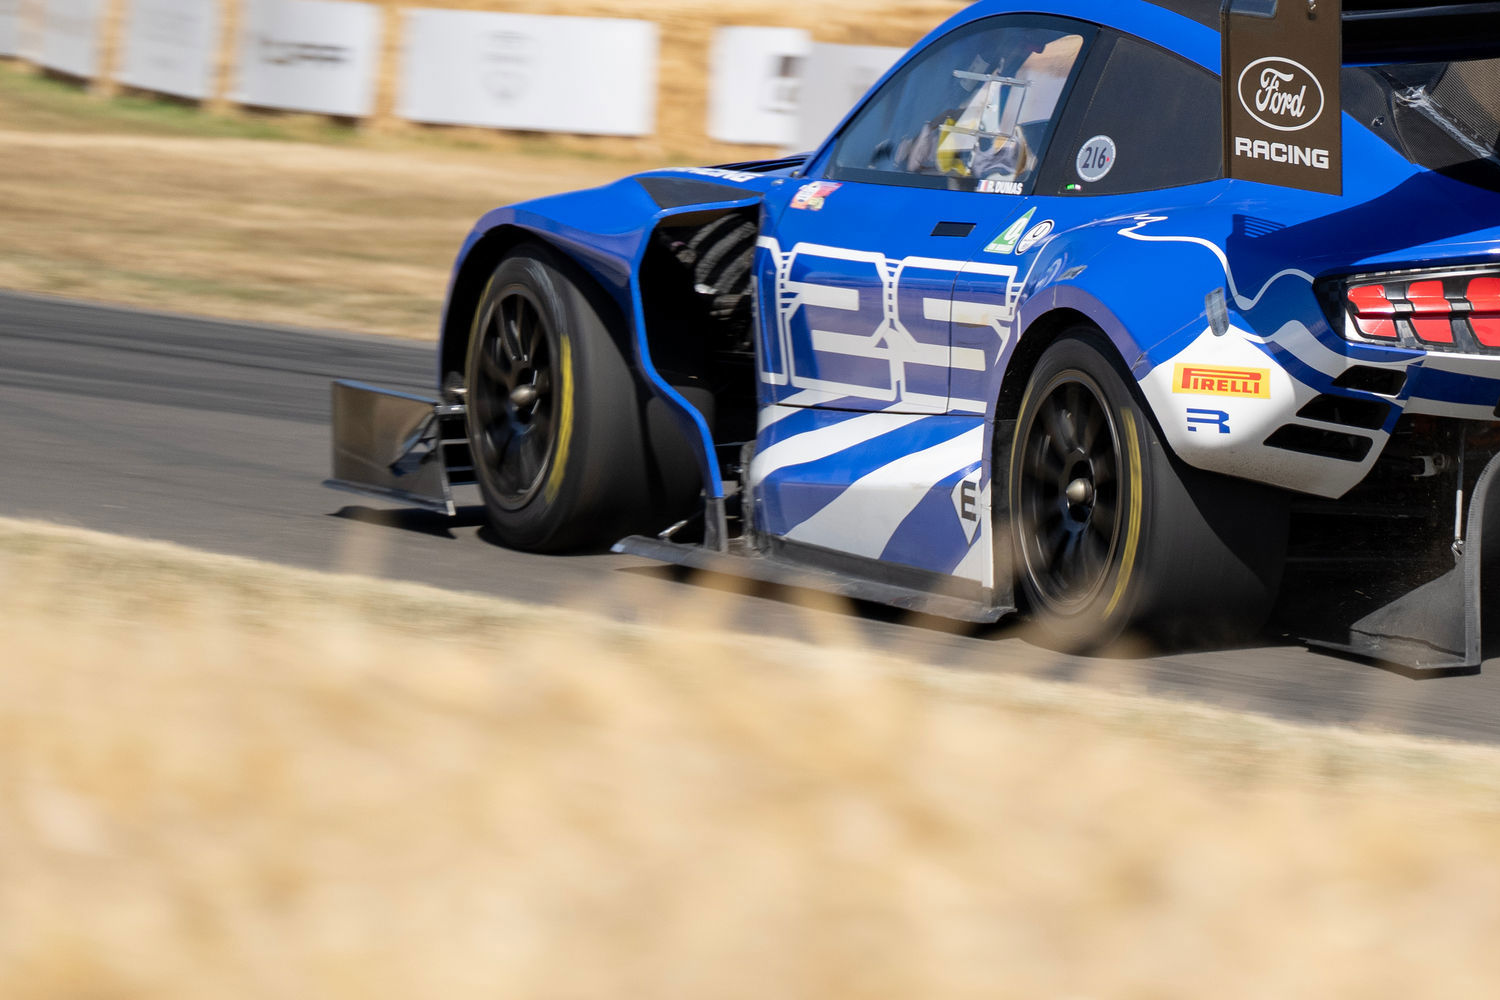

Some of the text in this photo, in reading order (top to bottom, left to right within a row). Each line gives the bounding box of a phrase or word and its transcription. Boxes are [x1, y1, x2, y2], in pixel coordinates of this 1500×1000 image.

[1255, 67, 1307, 118] Ford
[1081, 146, 1106, 169] 216
[1234, 136, 1330, 170] RACING
[995, 180, 1024, 195] DUMAS
[1181, 367, 1262, 395] PIRELLI
[960, 479, 977, 522] E
